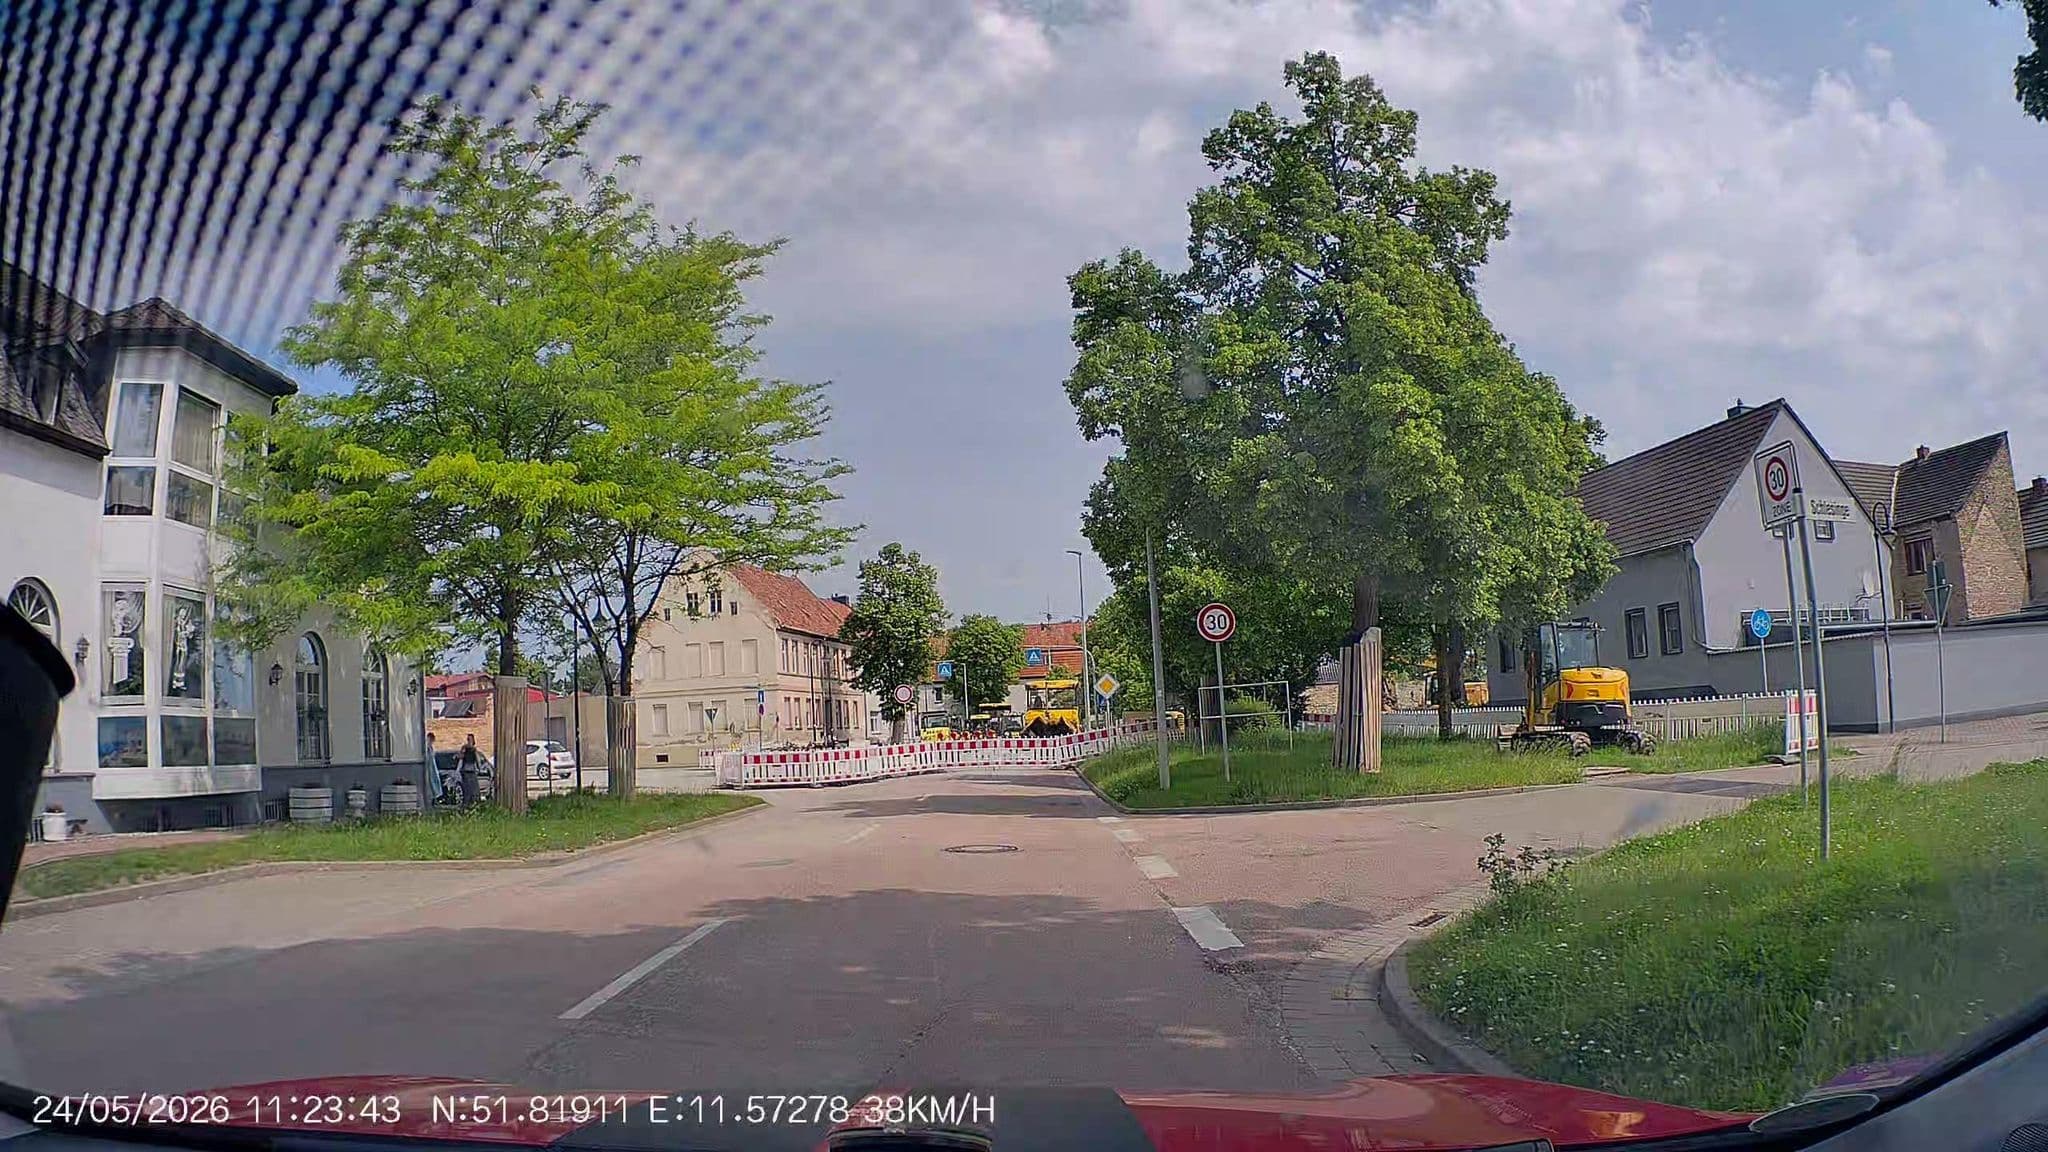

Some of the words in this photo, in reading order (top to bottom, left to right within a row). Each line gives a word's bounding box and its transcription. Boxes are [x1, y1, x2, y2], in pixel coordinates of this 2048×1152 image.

[1769, 467, 1785, 490] 30
[1772, 501, 1792, 517] ZONE
[1206, 614, 1227, 630] 30
